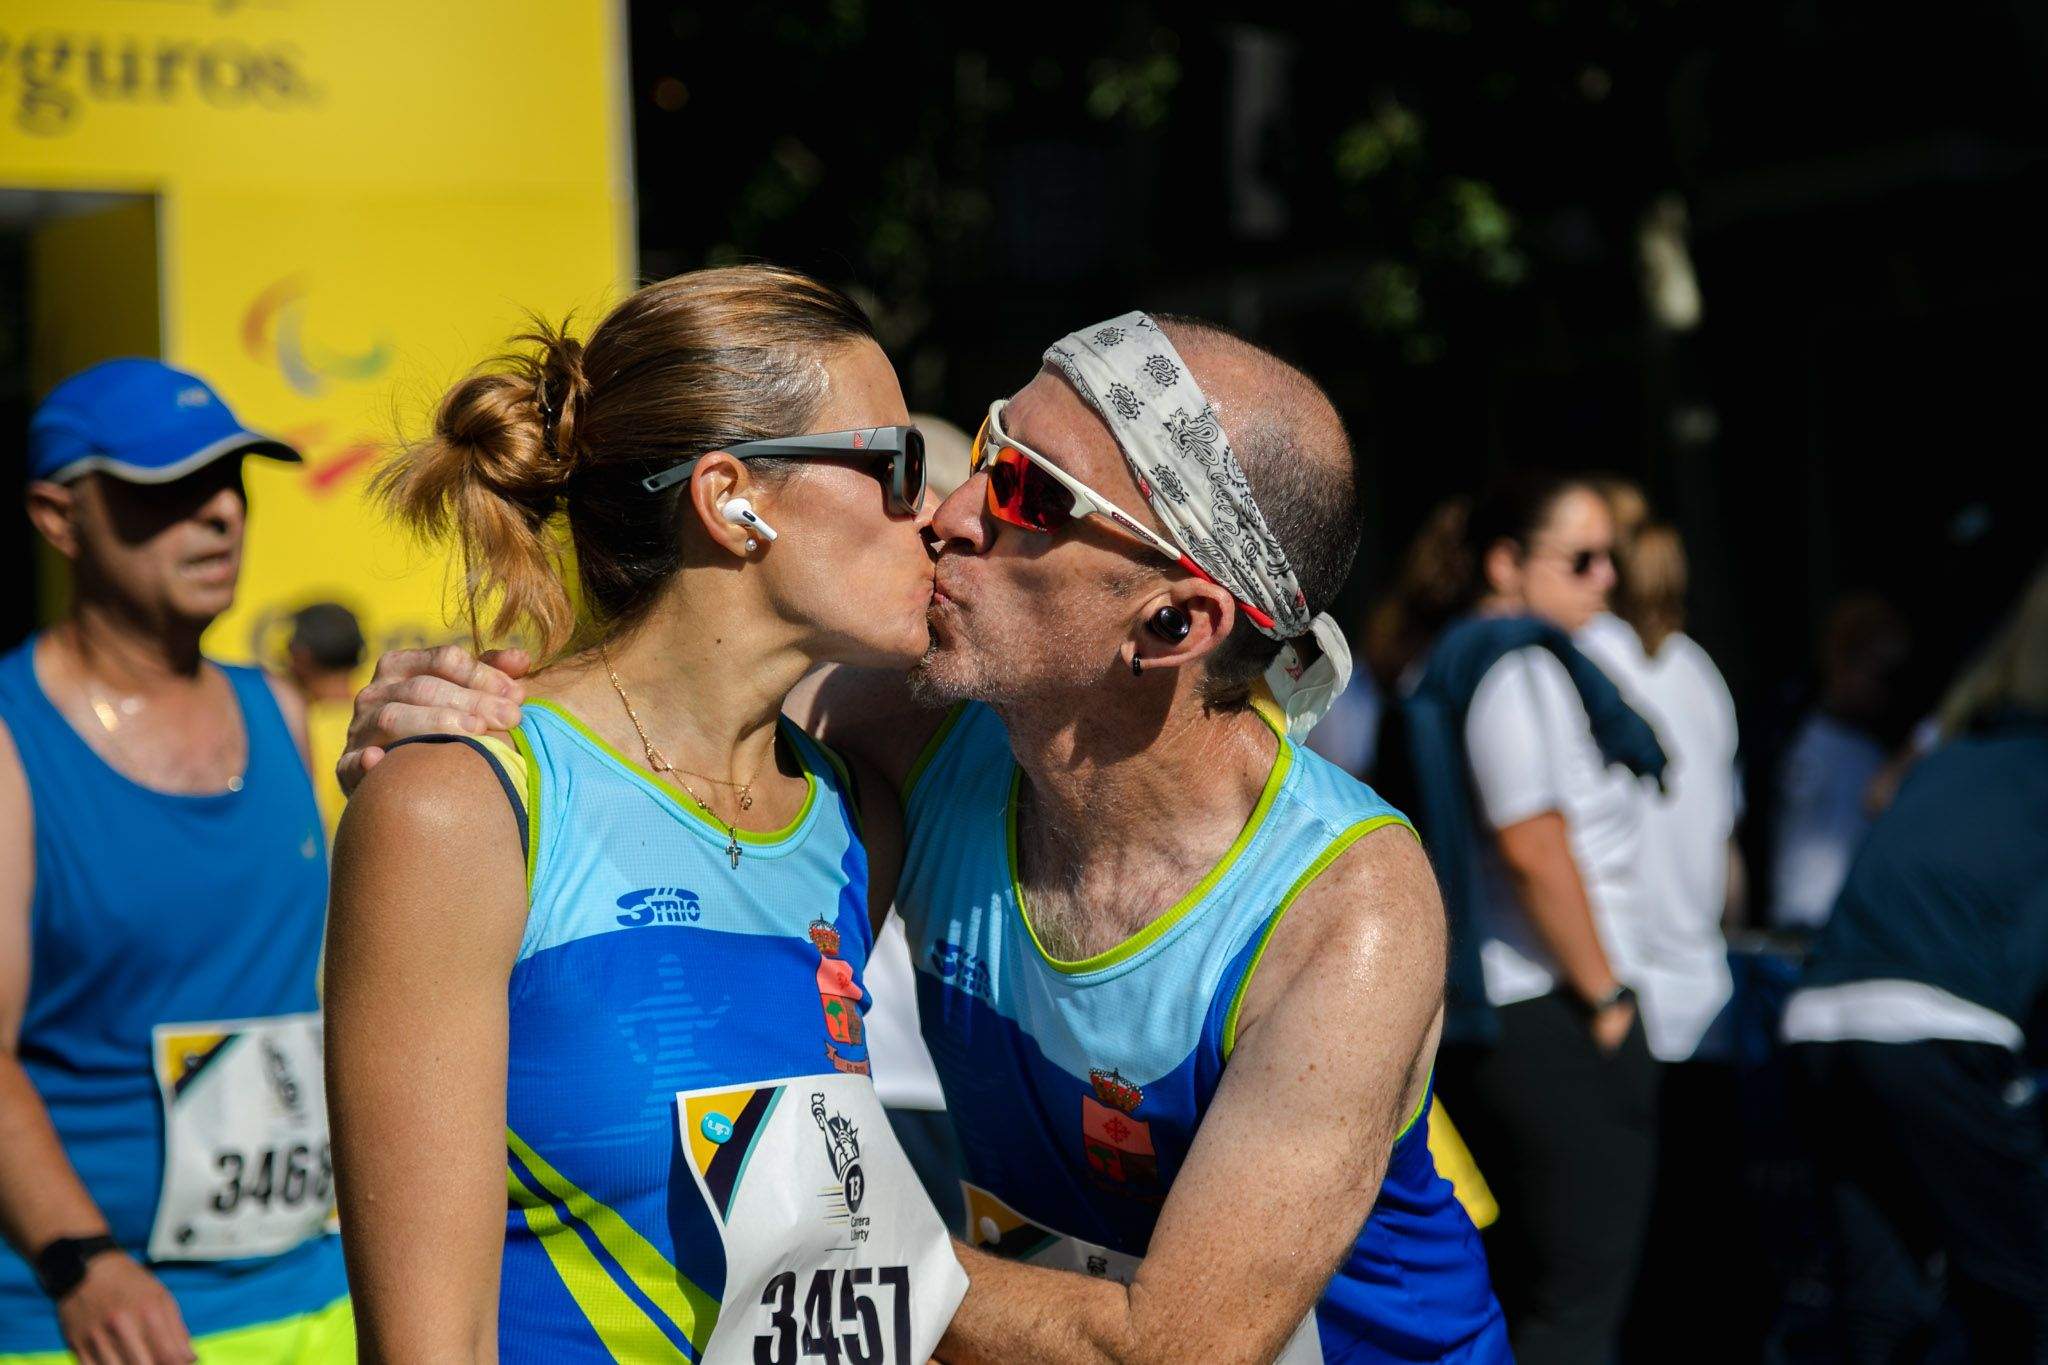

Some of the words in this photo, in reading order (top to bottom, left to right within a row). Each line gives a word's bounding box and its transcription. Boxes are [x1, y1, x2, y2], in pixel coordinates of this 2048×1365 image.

[616, 888, 700, 926] STRIO
[849, 1176, 861, 1201] 13
[753, 1266, 911, 1365] 3457
